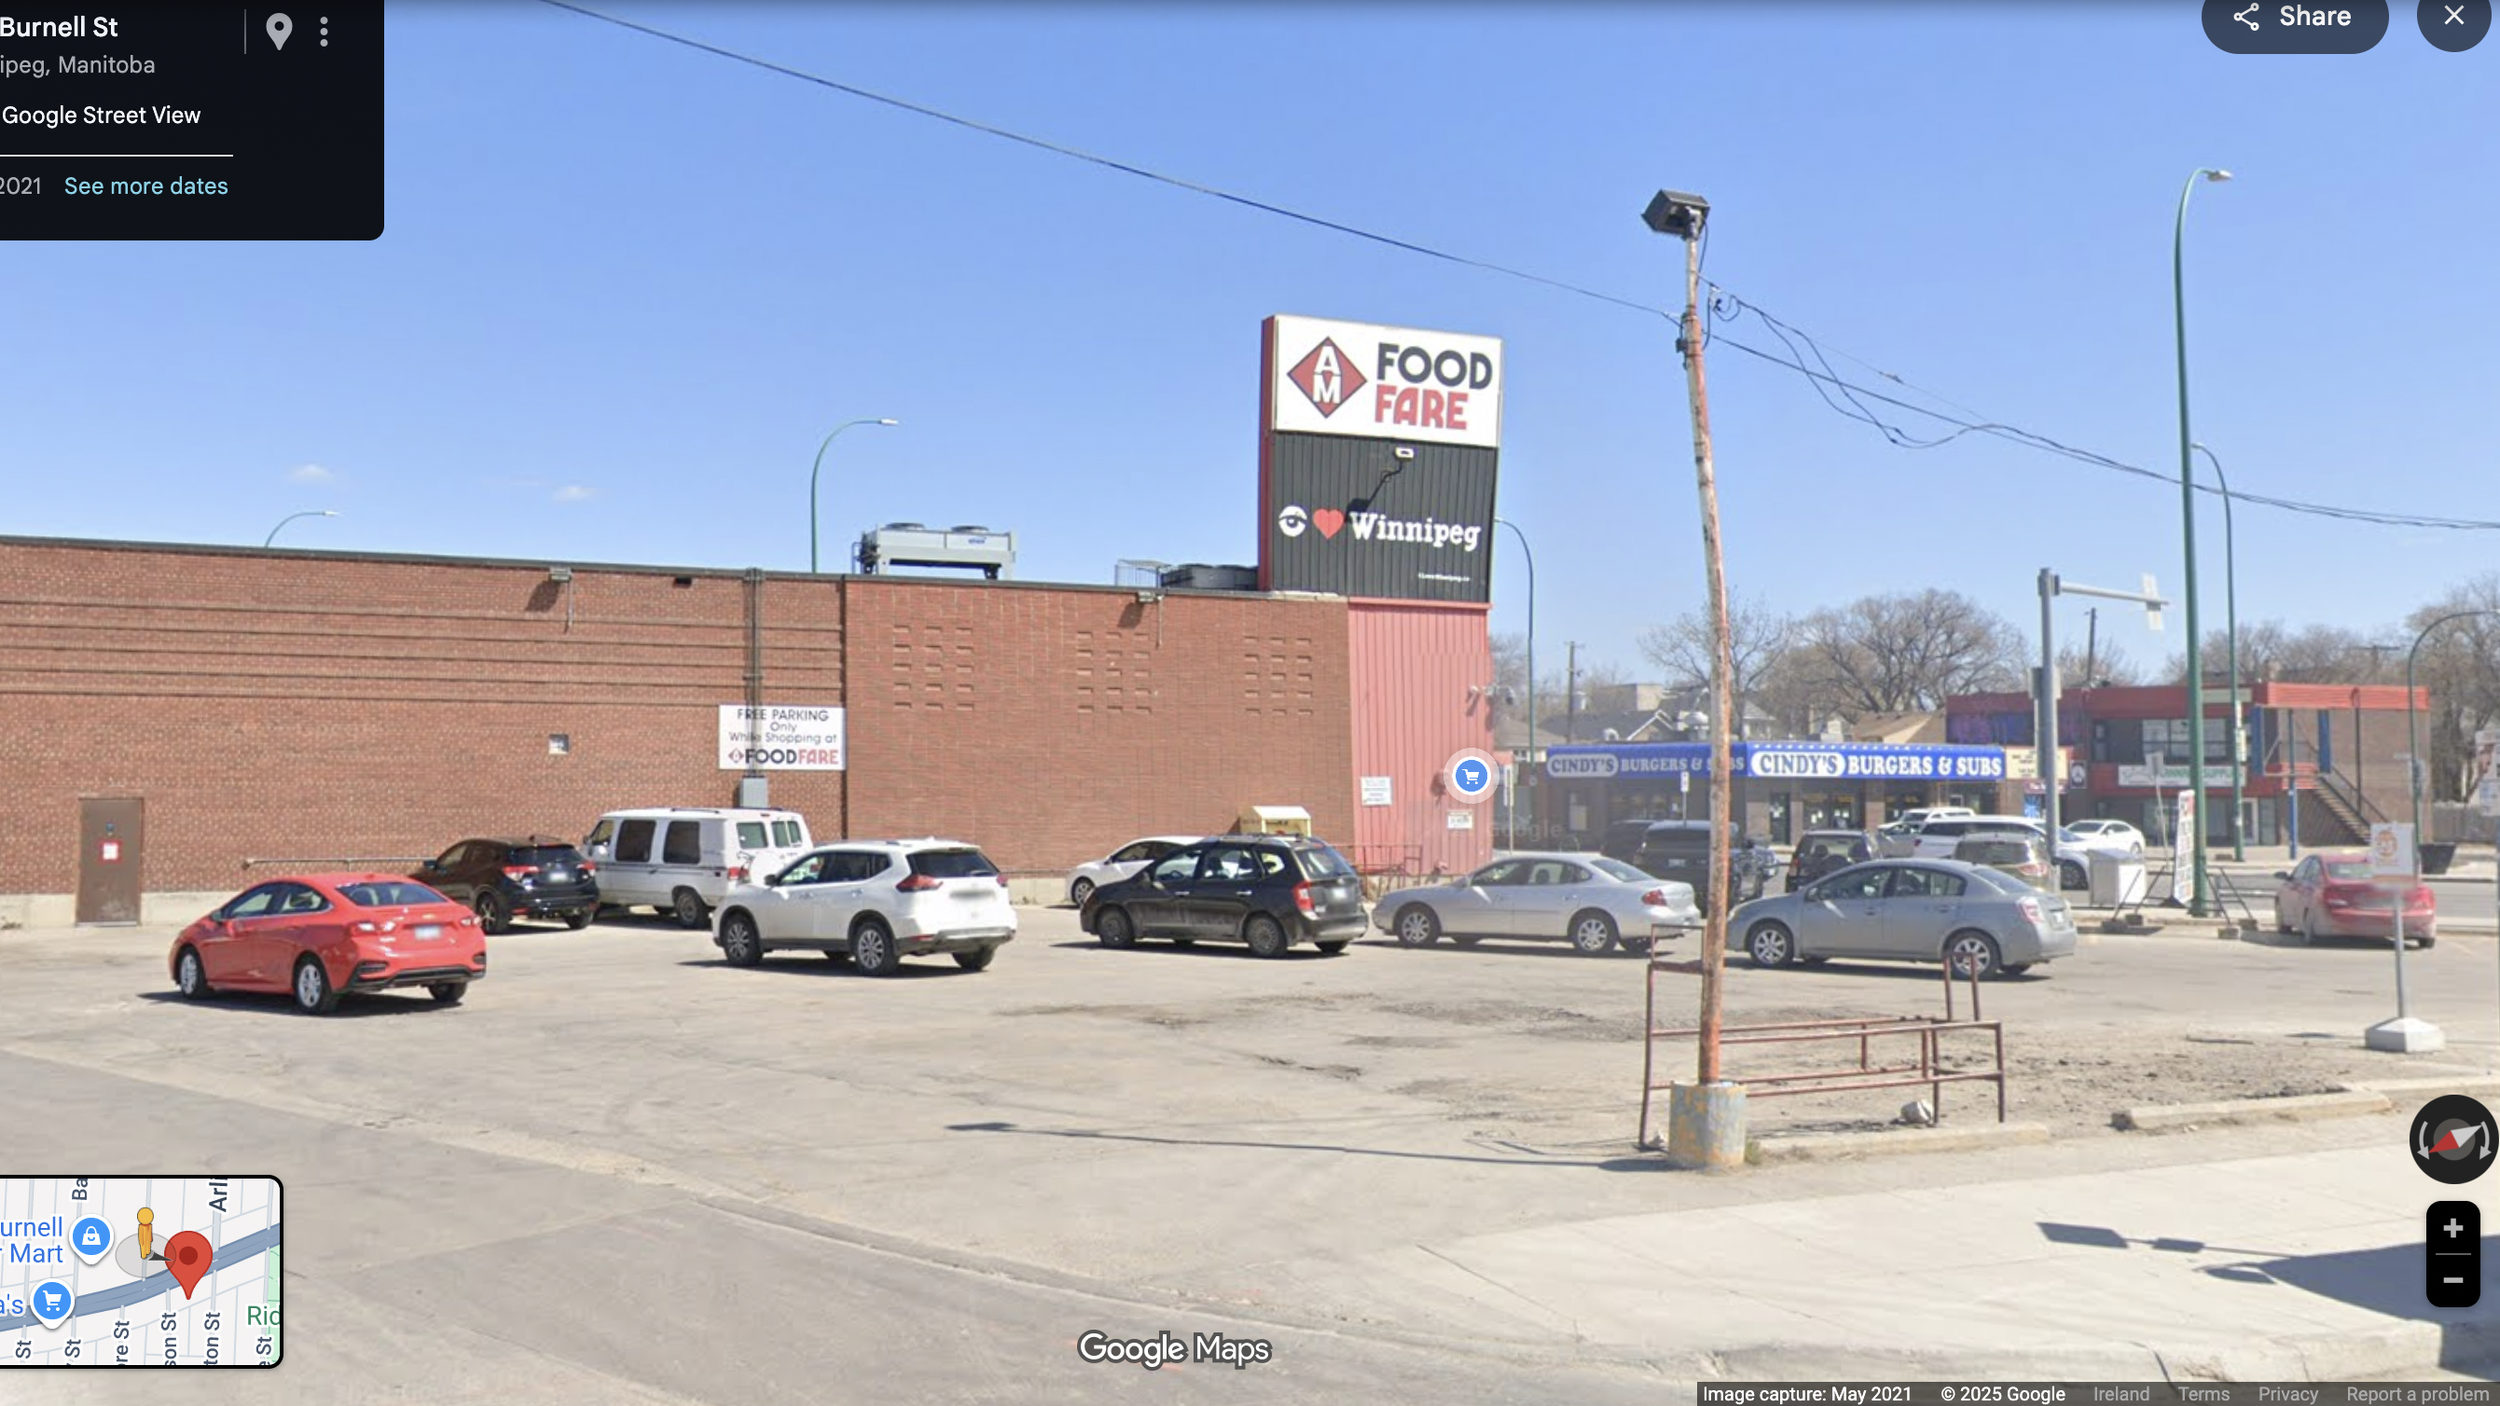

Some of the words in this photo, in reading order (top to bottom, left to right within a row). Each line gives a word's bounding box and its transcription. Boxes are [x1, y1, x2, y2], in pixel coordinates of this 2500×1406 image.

[1377, 342, 1493, 389] FOOD
[1375, 384, 1469, 430] FARE
[1350, 511, 1481, 551] Winnipeg
[737, 709, 767, 720] FREE
[773, 709, 829, 721] PARKING
[770, 721, 797, 732] Only
[729, 732, 761, 741] While
[766, 732, 821, 745] Shopping
[825, 734, 837, 743] at
[1551, 758, 1614, 772] CINDY'S
[1621, 758, 1687, 771] BURGERS
[1691, 757, 1702, 770] &
[1707, 757, 1745, 770] SBS
[1759, 752, 1838, 774] CINDY'S
[1848, 756, 1933, 775] BURGERS
[1938, 757, 1951, 775] &
[1957, 757, 2002, 776] SUBS
